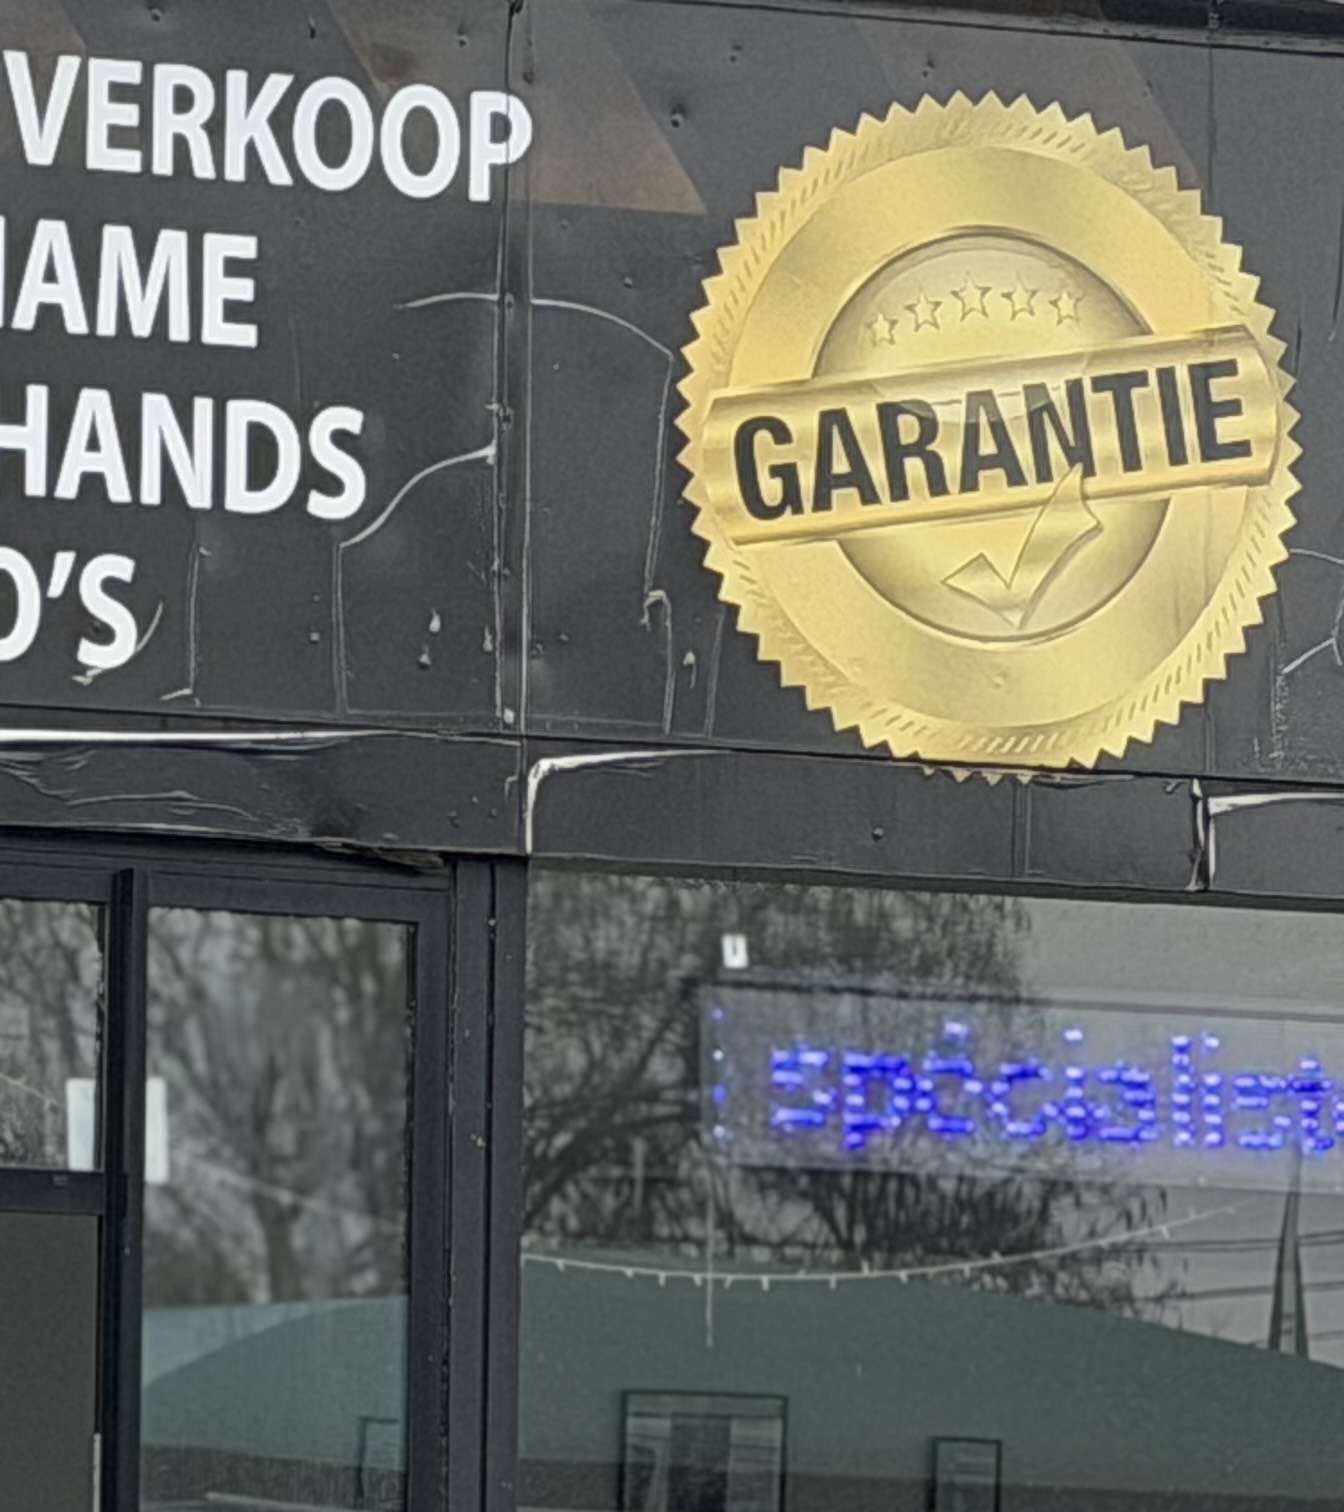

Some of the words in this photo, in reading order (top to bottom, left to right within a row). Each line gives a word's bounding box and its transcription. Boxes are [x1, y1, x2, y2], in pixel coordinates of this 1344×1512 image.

[2, 50, 534, 201] VERKOOP
[733, 357, 1253, 521] GARANTIE
[768, 1021, 1344, 1151] spécialist
